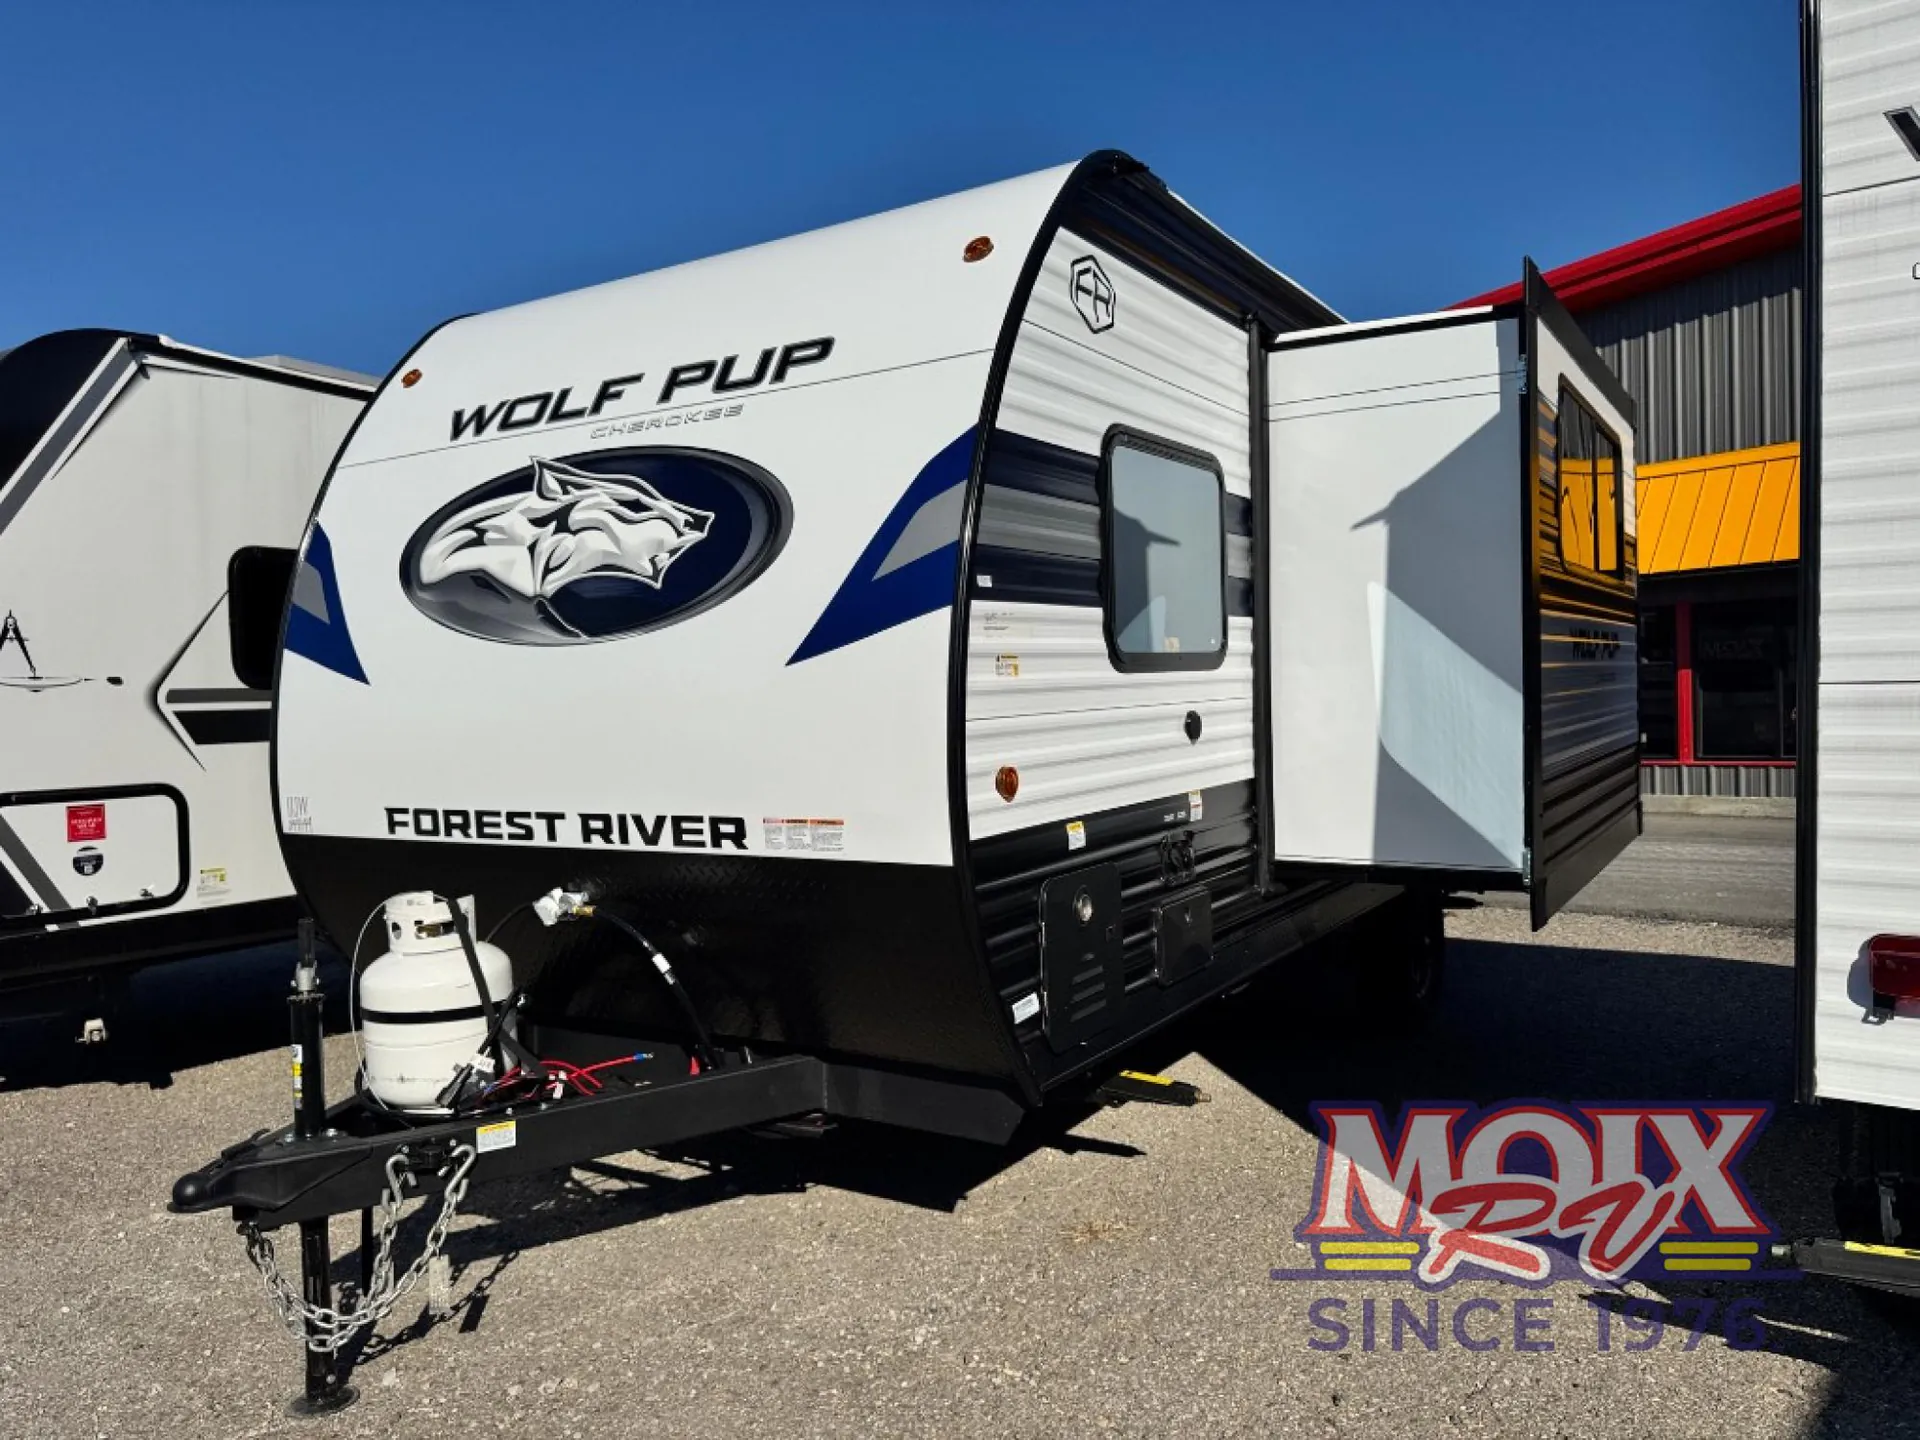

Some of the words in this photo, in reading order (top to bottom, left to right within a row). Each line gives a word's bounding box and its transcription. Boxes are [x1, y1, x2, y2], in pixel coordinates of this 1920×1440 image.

[449, 372, 646, 442] WOLF
[656, 336, 836, 405] PUP
[590, 403, 744, 439] CHEROKEE
[384, 807, 566, 842] FOREST
[578, 812, 749, 850] RIVER
